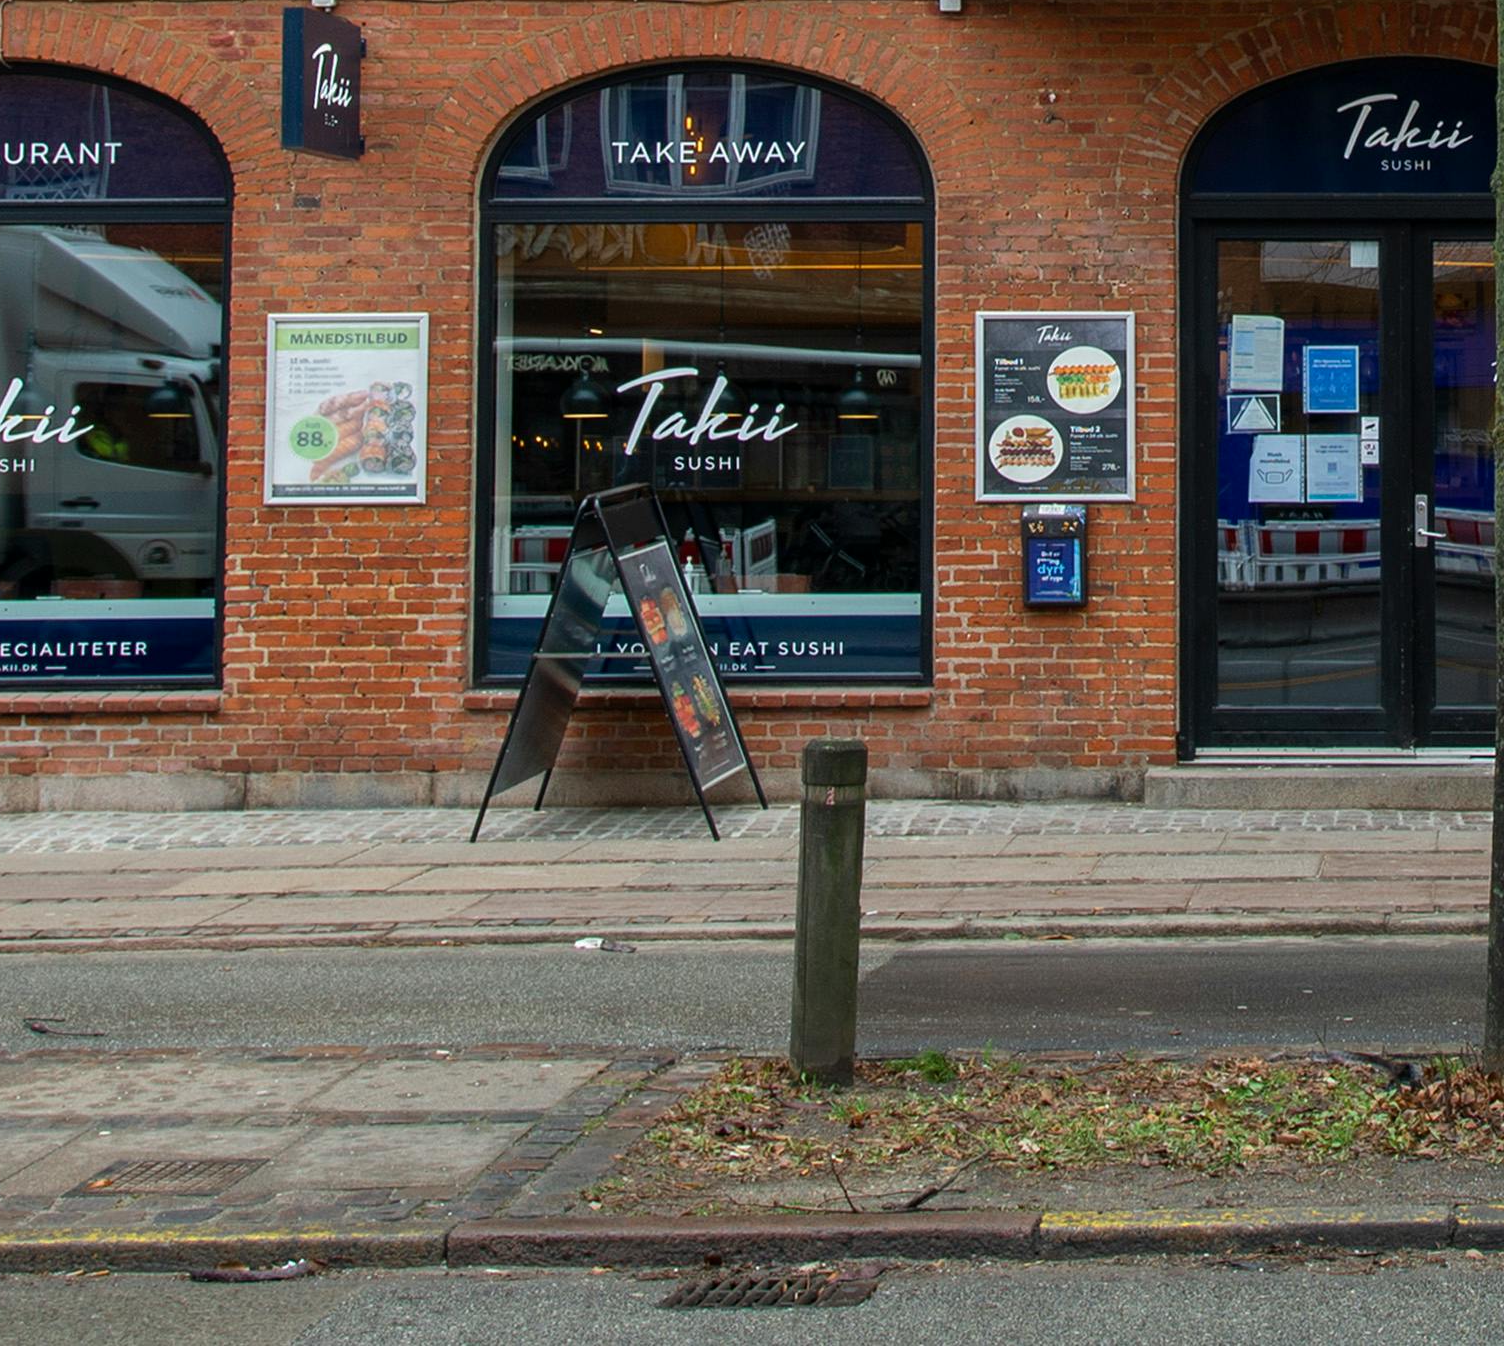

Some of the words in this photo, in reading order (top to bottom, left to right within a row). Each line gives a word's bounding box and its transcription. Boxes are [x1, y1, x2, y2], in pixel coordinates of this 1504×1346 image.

[311, 43, 353, 110] Takii
[1337, 93, 1474, 159] Takii
[611, 141, 697, 165] TAKE
[708, 141, 807, 165] AWAY
[1380, 159, 1432, 171] SUSHI
[289, 330, 409, 346] MÅNEDSTILBUD
[1036, 325, 1073, 344] Takii
[616, 367, 799, 455] Takii
[674, 456, 741, 471] SUSHI
[1037, 564, 1065, 576] dyrt
[729, 641, 770, 656] EAT
[777, 641, 845, 656] SUSHI
